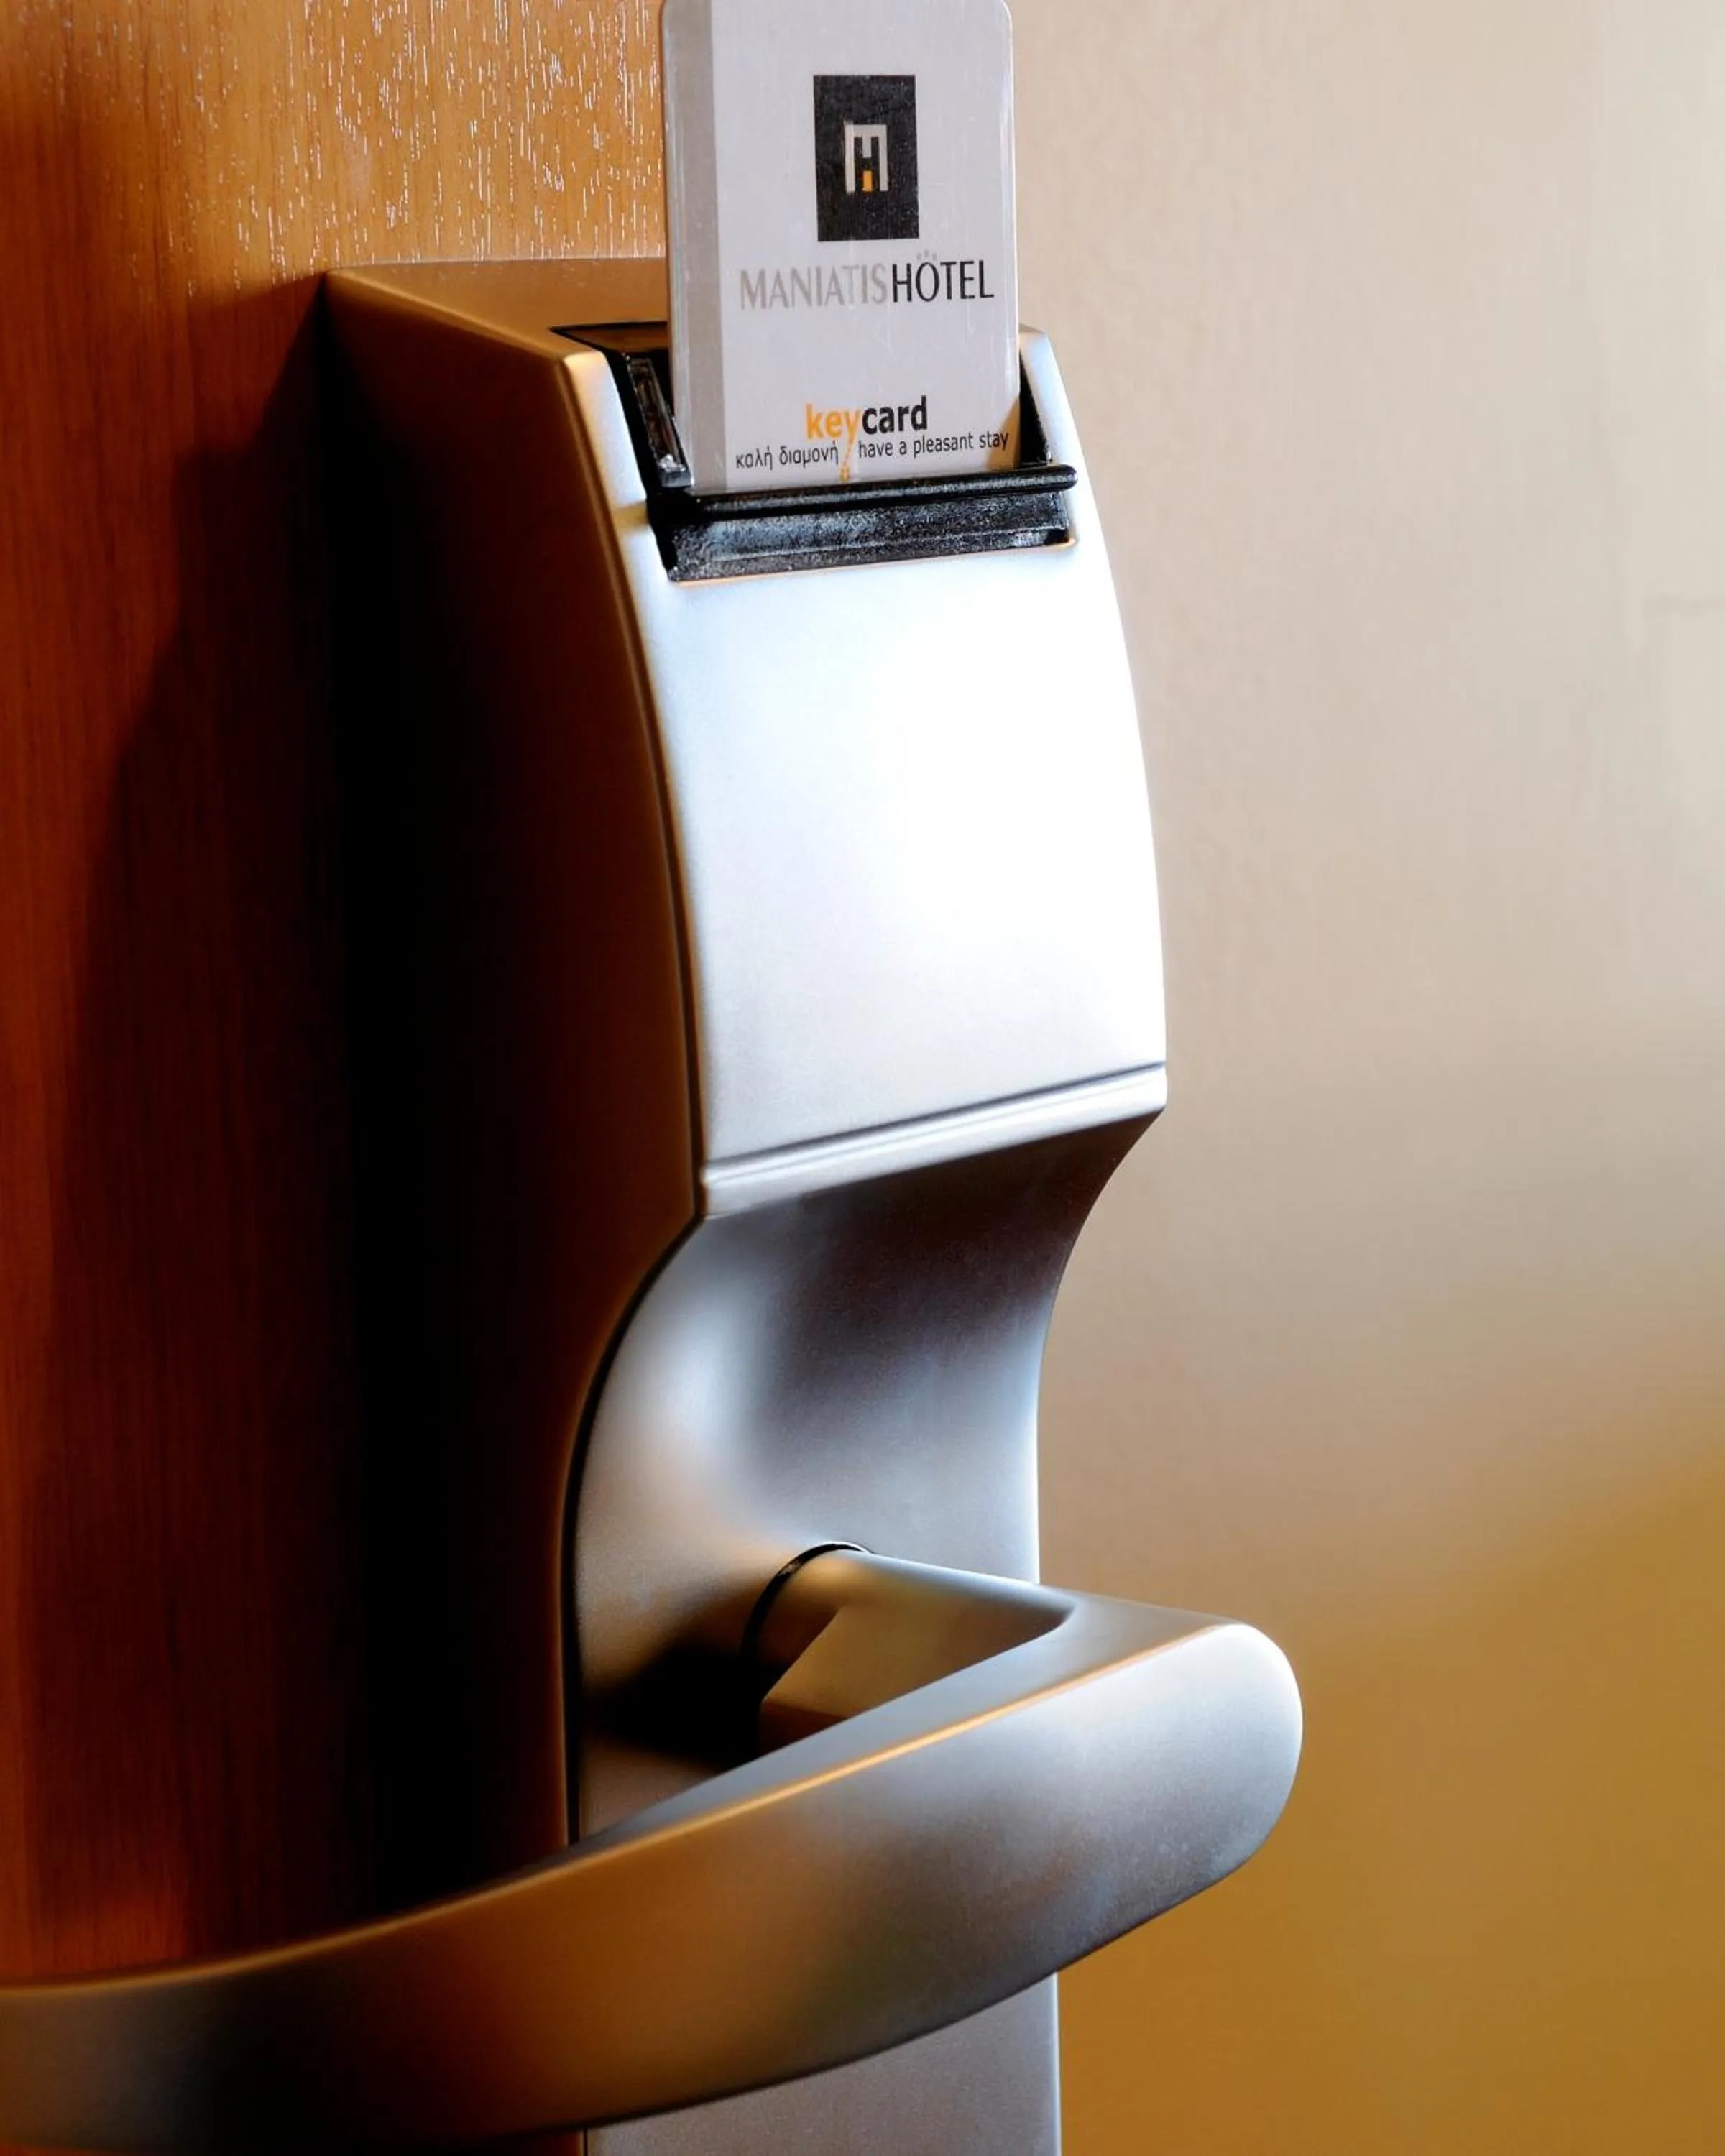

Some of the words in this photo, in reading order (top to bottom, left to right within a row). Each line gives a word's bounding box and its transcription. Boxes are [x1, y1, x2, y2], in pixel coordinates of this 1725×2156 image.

[805, 395, 928, 447] keycard
[735, 445, 773, 470] καλή
[778, 440, 839, 469] διαμονή
[858, 440, 893, 459] have
[898, 440, 907, 456] a
[913, 432, 974, 459] pleasant
[979, 430, 1009, 451] stay
